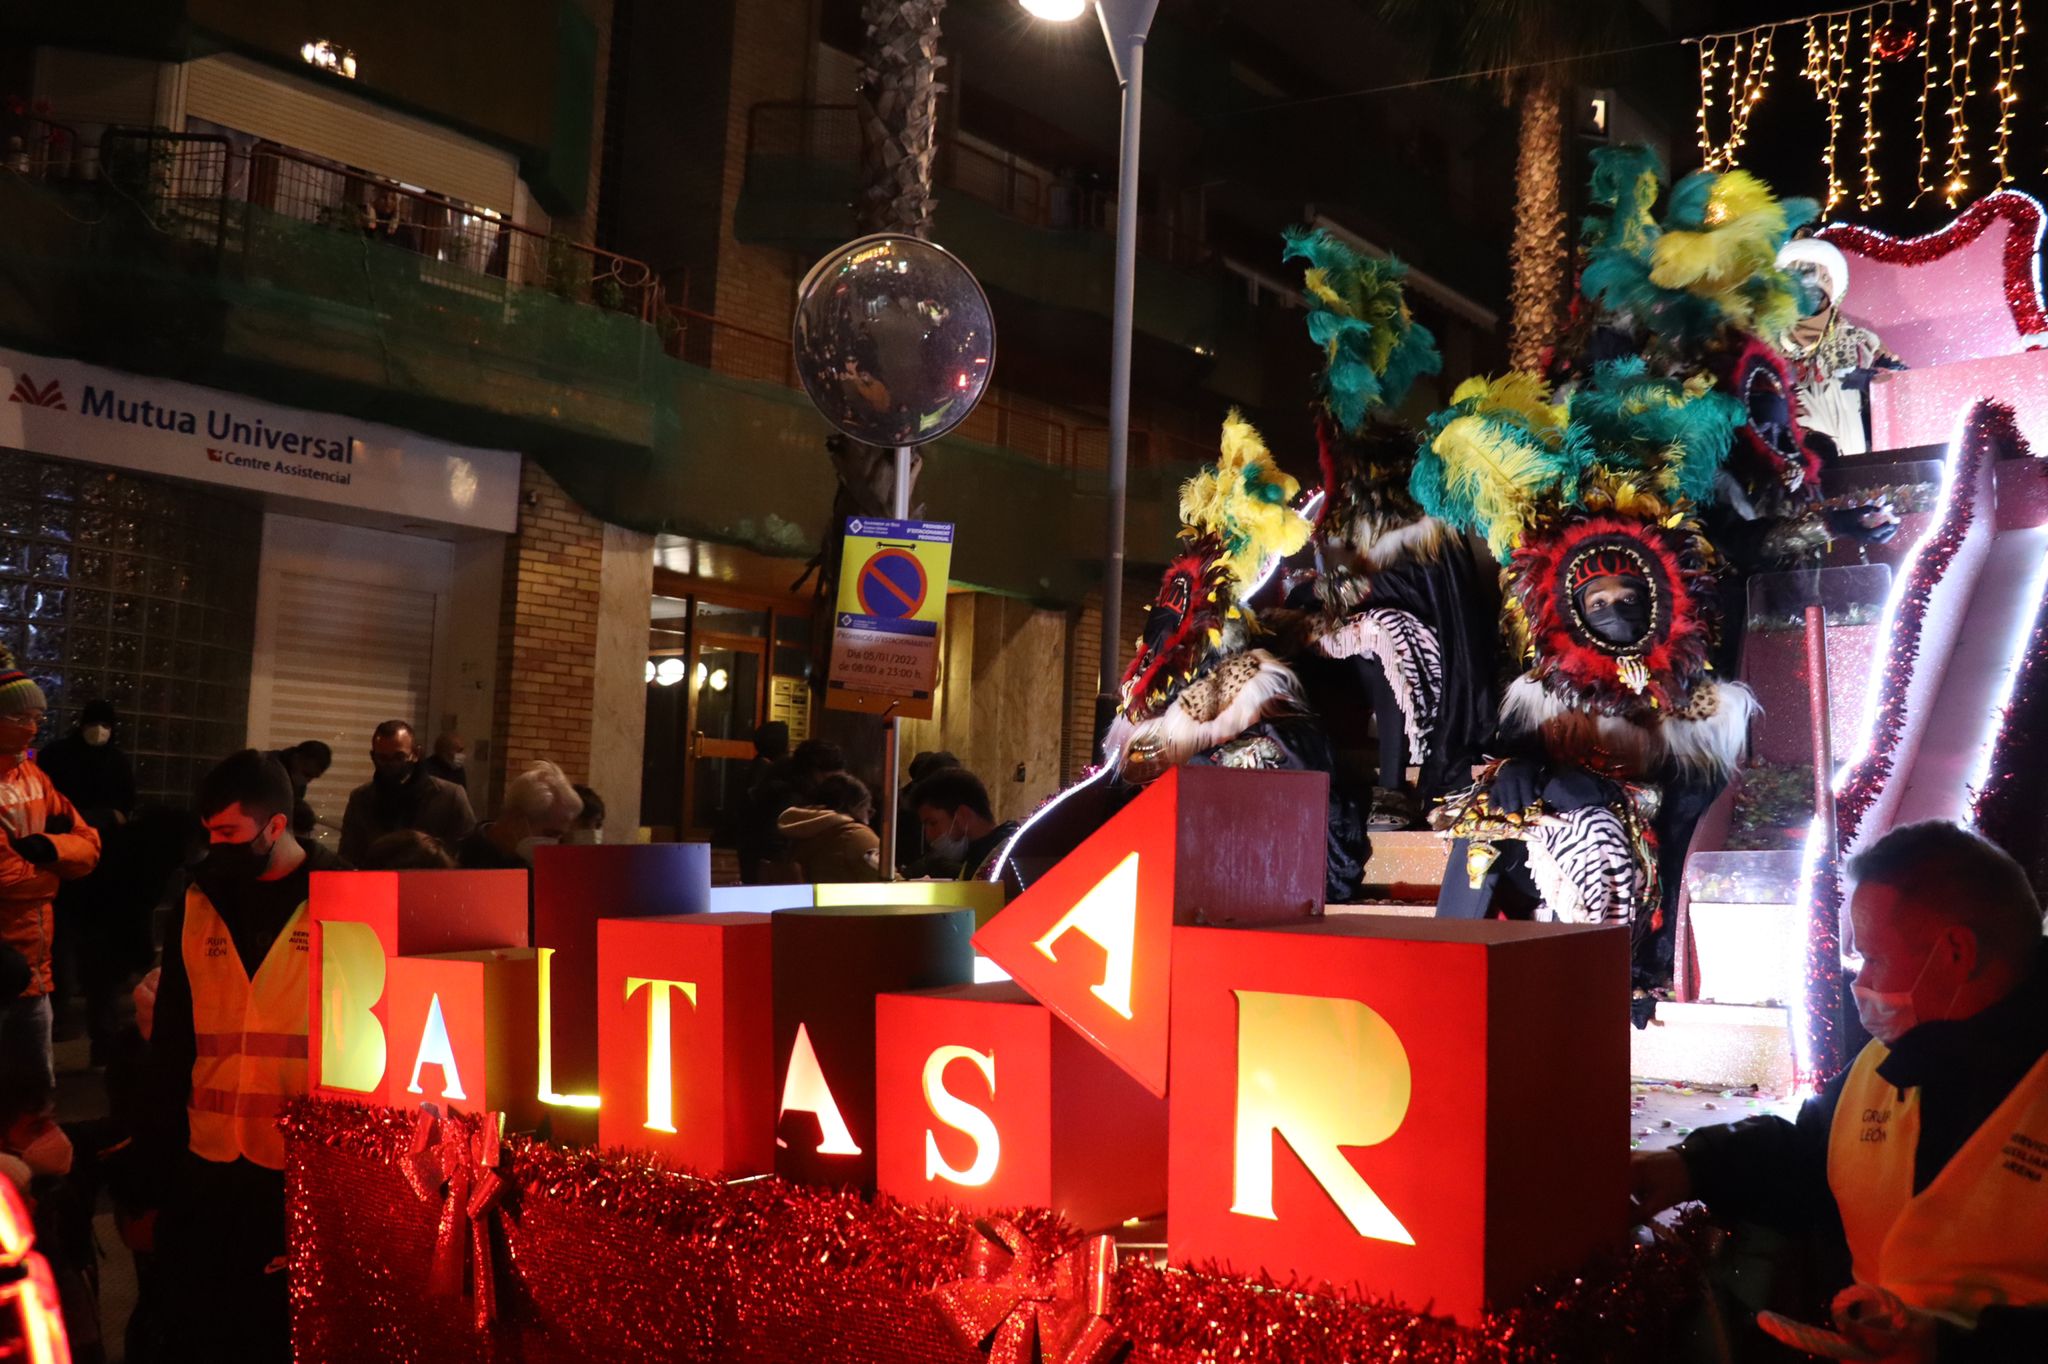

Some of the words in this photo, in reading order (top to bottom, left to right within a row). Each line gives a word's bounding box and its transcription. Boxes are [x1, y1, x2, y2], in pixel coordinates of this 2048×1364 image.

[81, 385, 196, 434] Mutua
[207, 410, 353, 464] Universal
[225, 452, 270, 471] Centre
[275, 461, 351, 485] Assistencial
[863, 650, 918, 666] 05/01/2022
[838, 662, 849, 672] de
[878, 667, 885, 675] a
[887, 667, 913, 679] 23:00
[1862, 1108, 1891, 1123] GRUP
